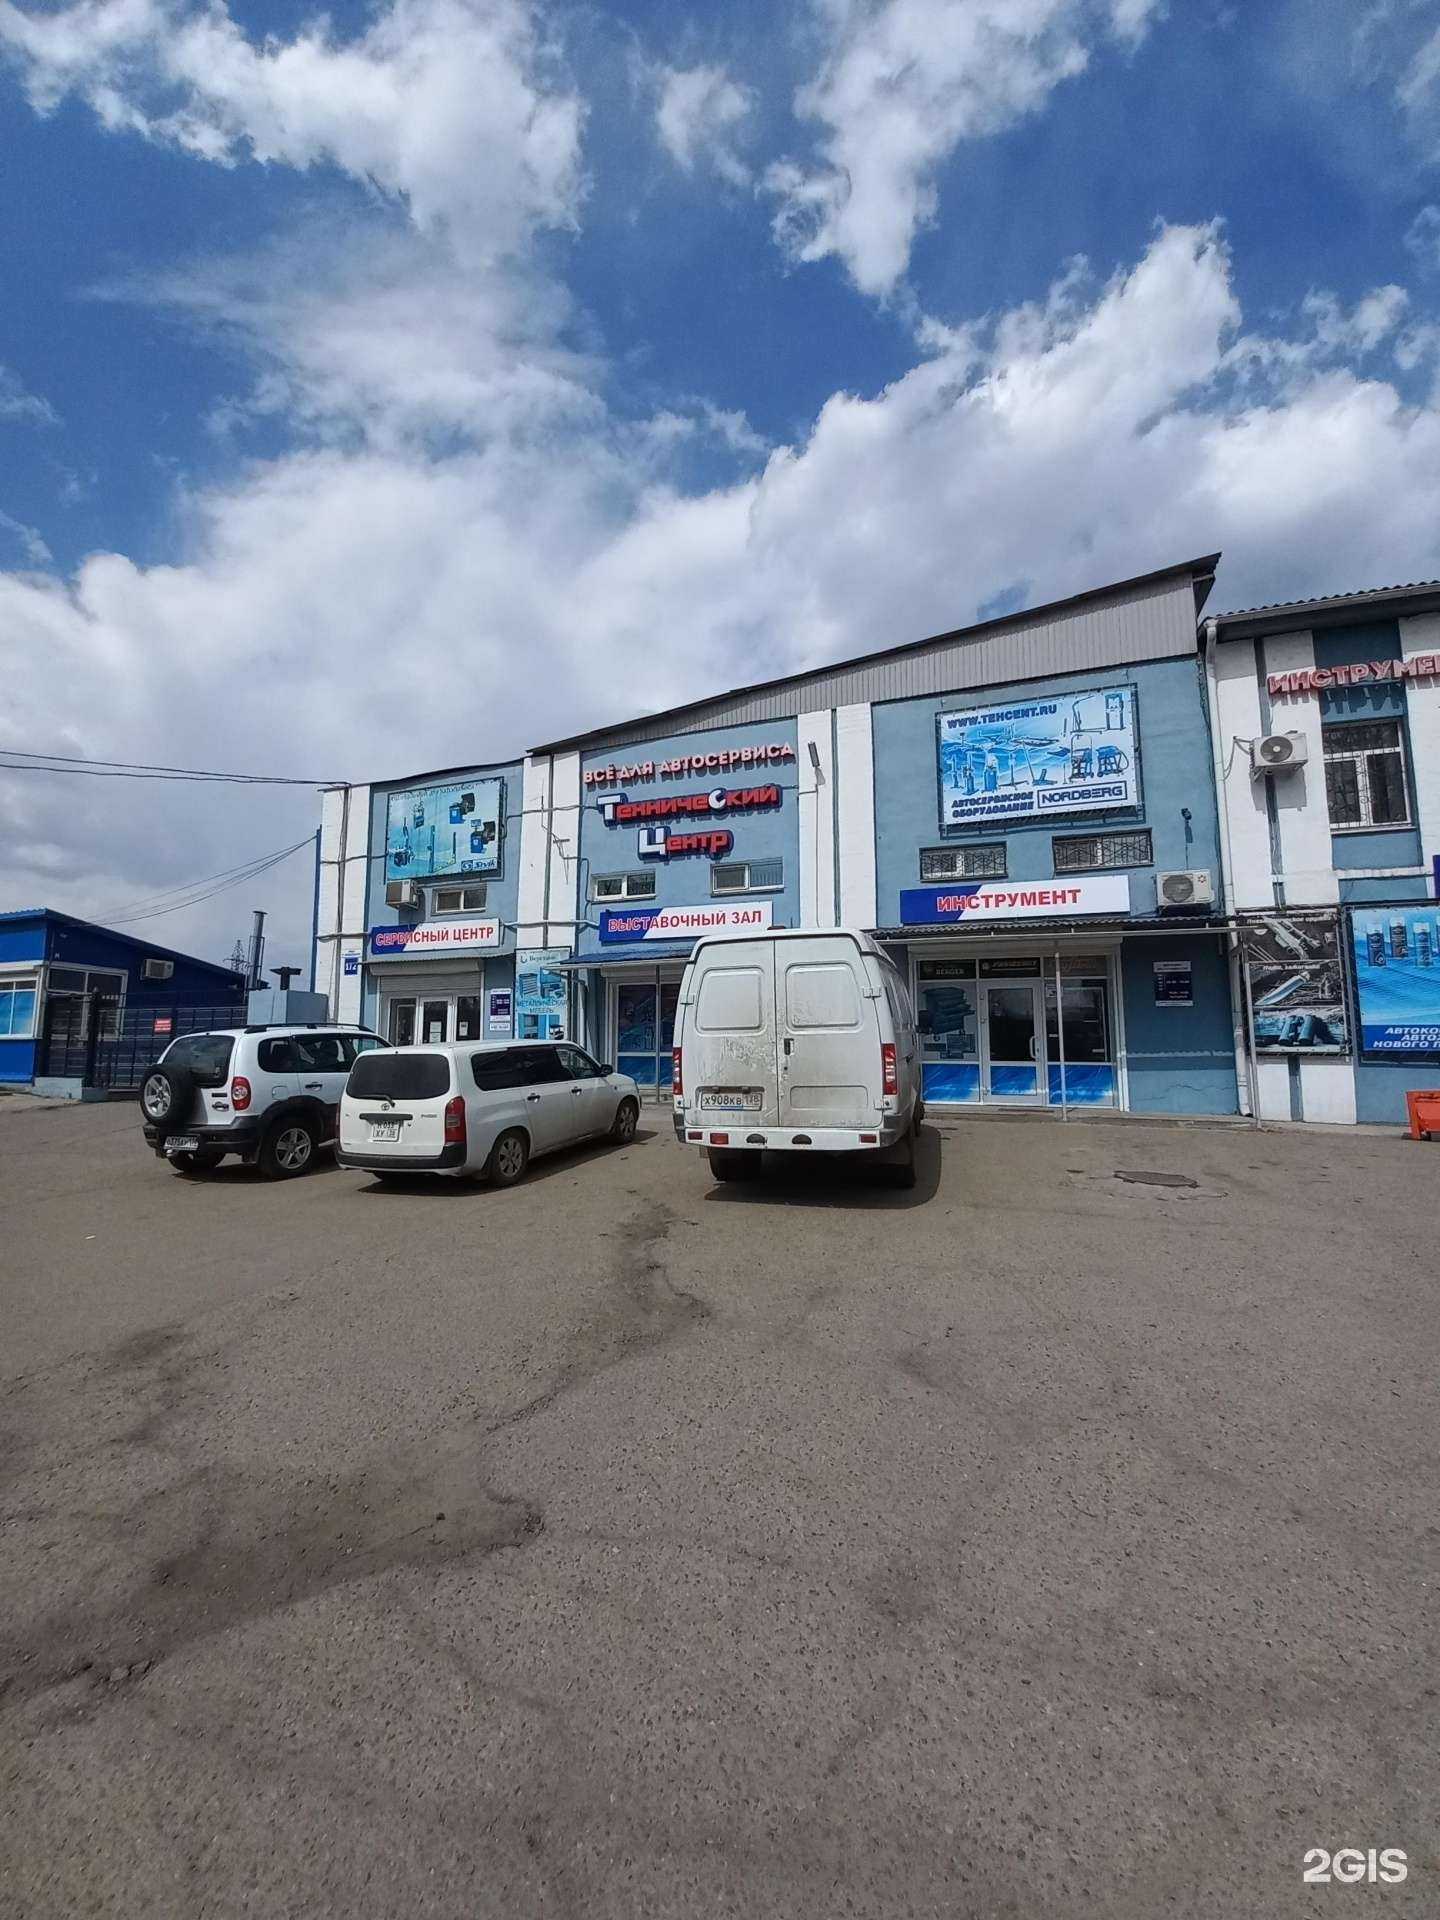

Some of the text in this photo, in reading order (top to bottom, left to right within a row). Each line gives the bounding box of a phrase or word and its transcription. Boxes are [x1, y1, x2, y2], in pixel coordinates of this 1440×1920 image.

[946, 703, 1057, 729] WWW.TEHCENT.RU
[584, 743, 795, 783] ВСЁ ДЛЯ АВТОСЕРВИСА
[951, 790, 1034, 809] АВТОСЕРВИСНОЕ
[1041, 785, 1123, 804] NORDBERG
[952, 801, 1034, 818] ОБОРУДОВАНИЕ
[936, 889, 1081, 913] ИНСТРУМЕНТ
[608, 910, 762, 933] ВЫСТАВОЧНЫЙ ЗАЛ
[375, 926, 494, 946] СЕРВИСНЫЙ ЦЕНТР
[1385, 1027, 1440, 1035] АВТОКО
[1373, 1040, 1429, 1048] НОВОГО
